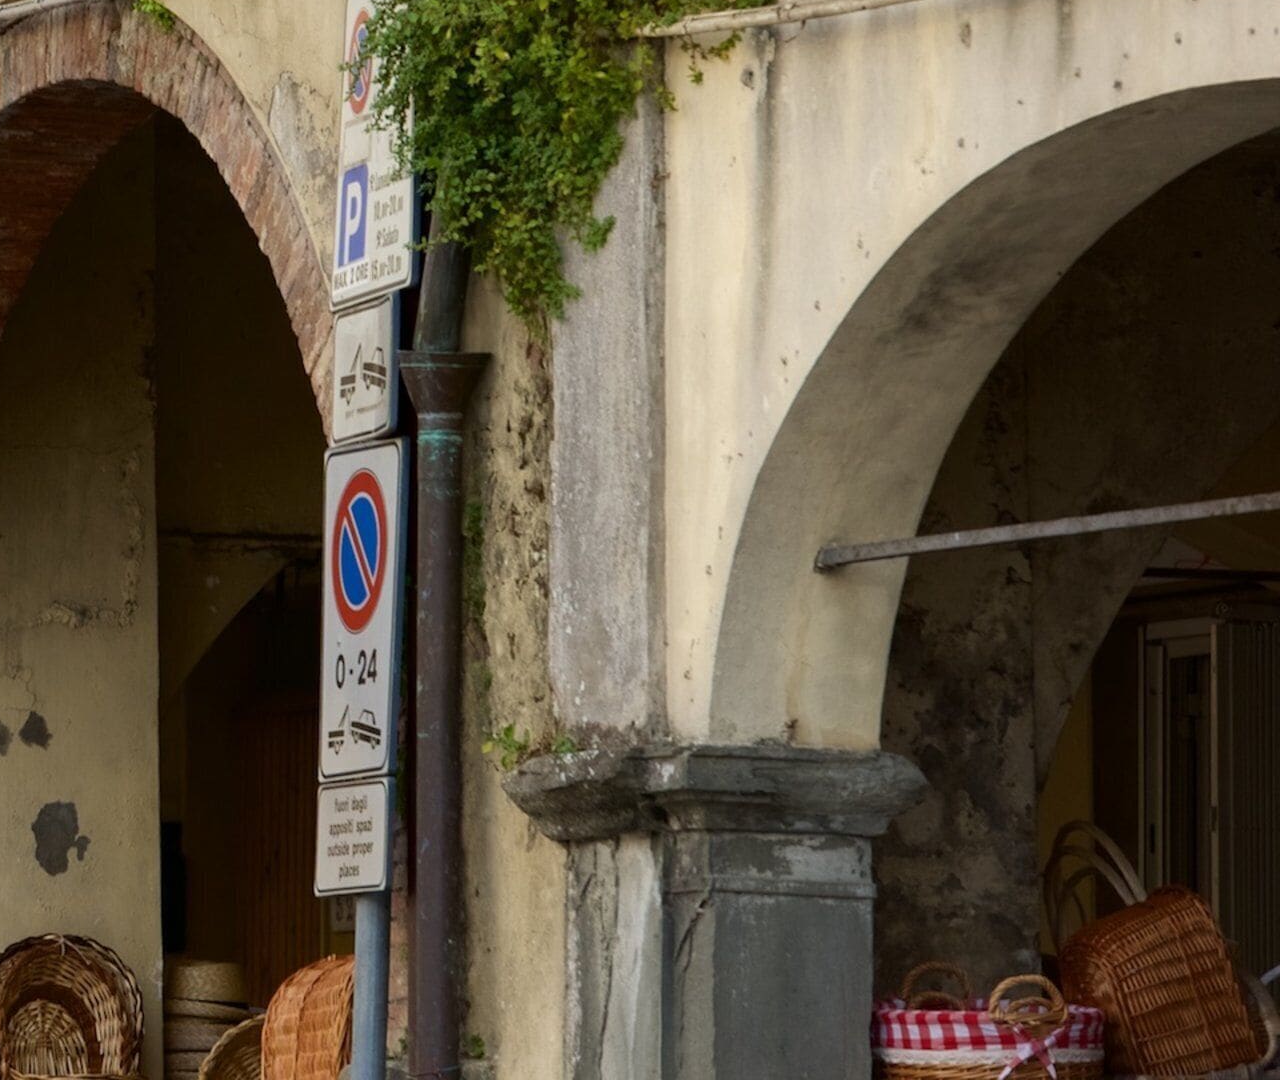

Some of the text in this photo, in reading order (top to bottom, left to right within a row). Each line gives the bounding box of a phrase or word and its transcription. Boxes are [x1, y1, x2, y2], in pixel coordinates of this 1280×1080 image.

[346, 181, 362, 264] P
[335, 653, 346, 689] 0
[357, 648, 378, 685] 24
[334, 795, 368, 814] fuori dagli
[329, 816, 373, 837] appositi spazi
[327, 841, 374, 858] outside proper
[338, 863, 360, 881] places
